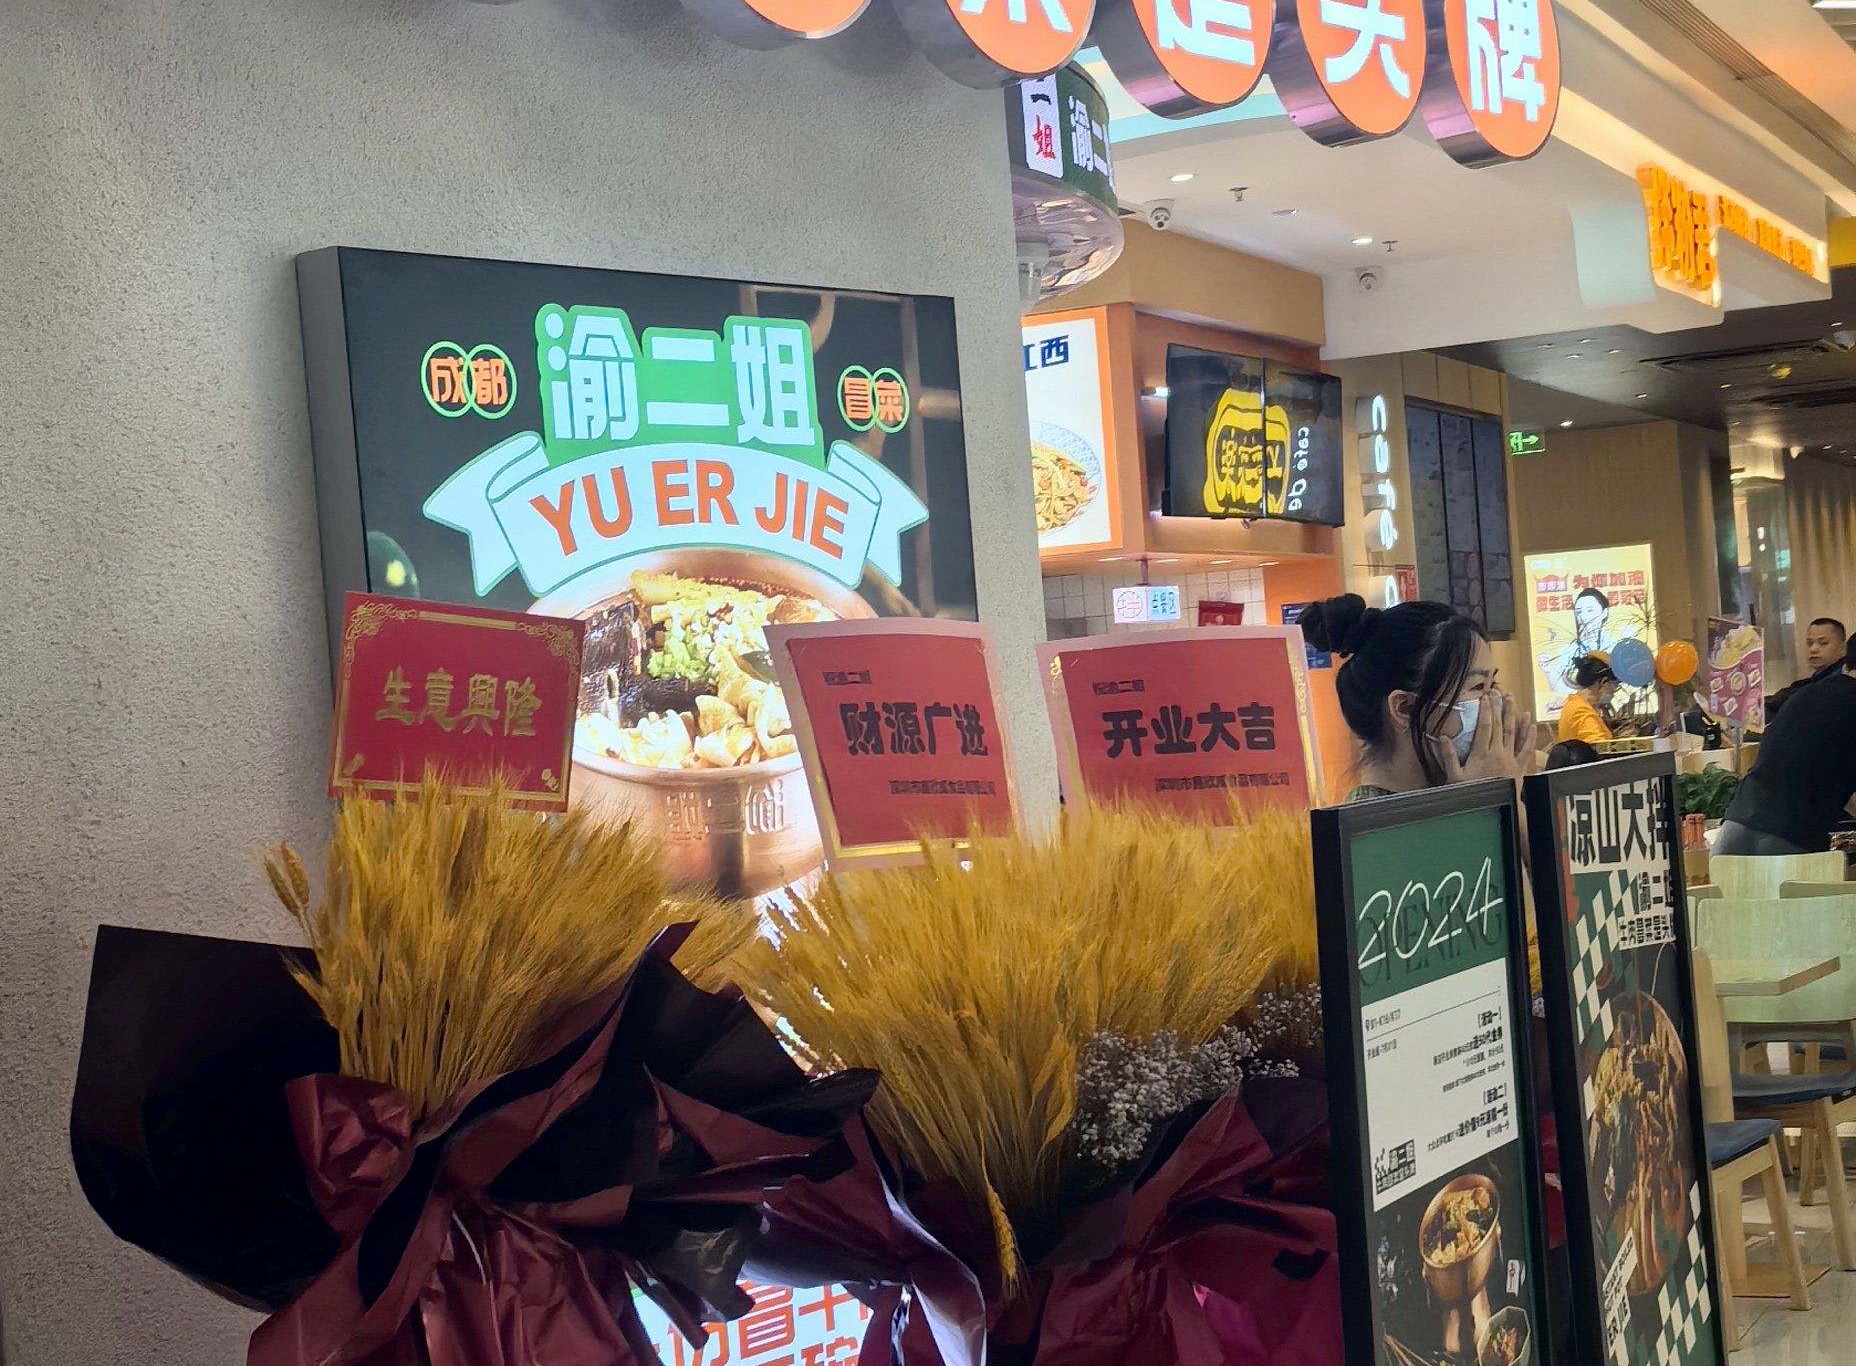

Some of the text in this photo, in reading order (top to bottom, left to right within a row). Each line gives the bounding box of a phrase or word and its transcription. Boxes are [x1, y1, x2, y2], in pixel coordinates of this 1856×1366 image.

[1068, 95, 1115, 192] 渝二
[428, 355, 509, 406] 成都
[545, 313, 816, 446] 渝二姐
[844, 377, 905, 424] 冒菜
[530, 459, 850, 559] YU ER JIE
[375, 665, 543, 737] 生意興隆
[839, 701, 989, 756] 财源广进
[1102, 701, 1277, 758] 开业大吉
[1358, 856, 1504, 970] 2024
[1619, 913, 1675, 945] 牛肉冒菜是头
